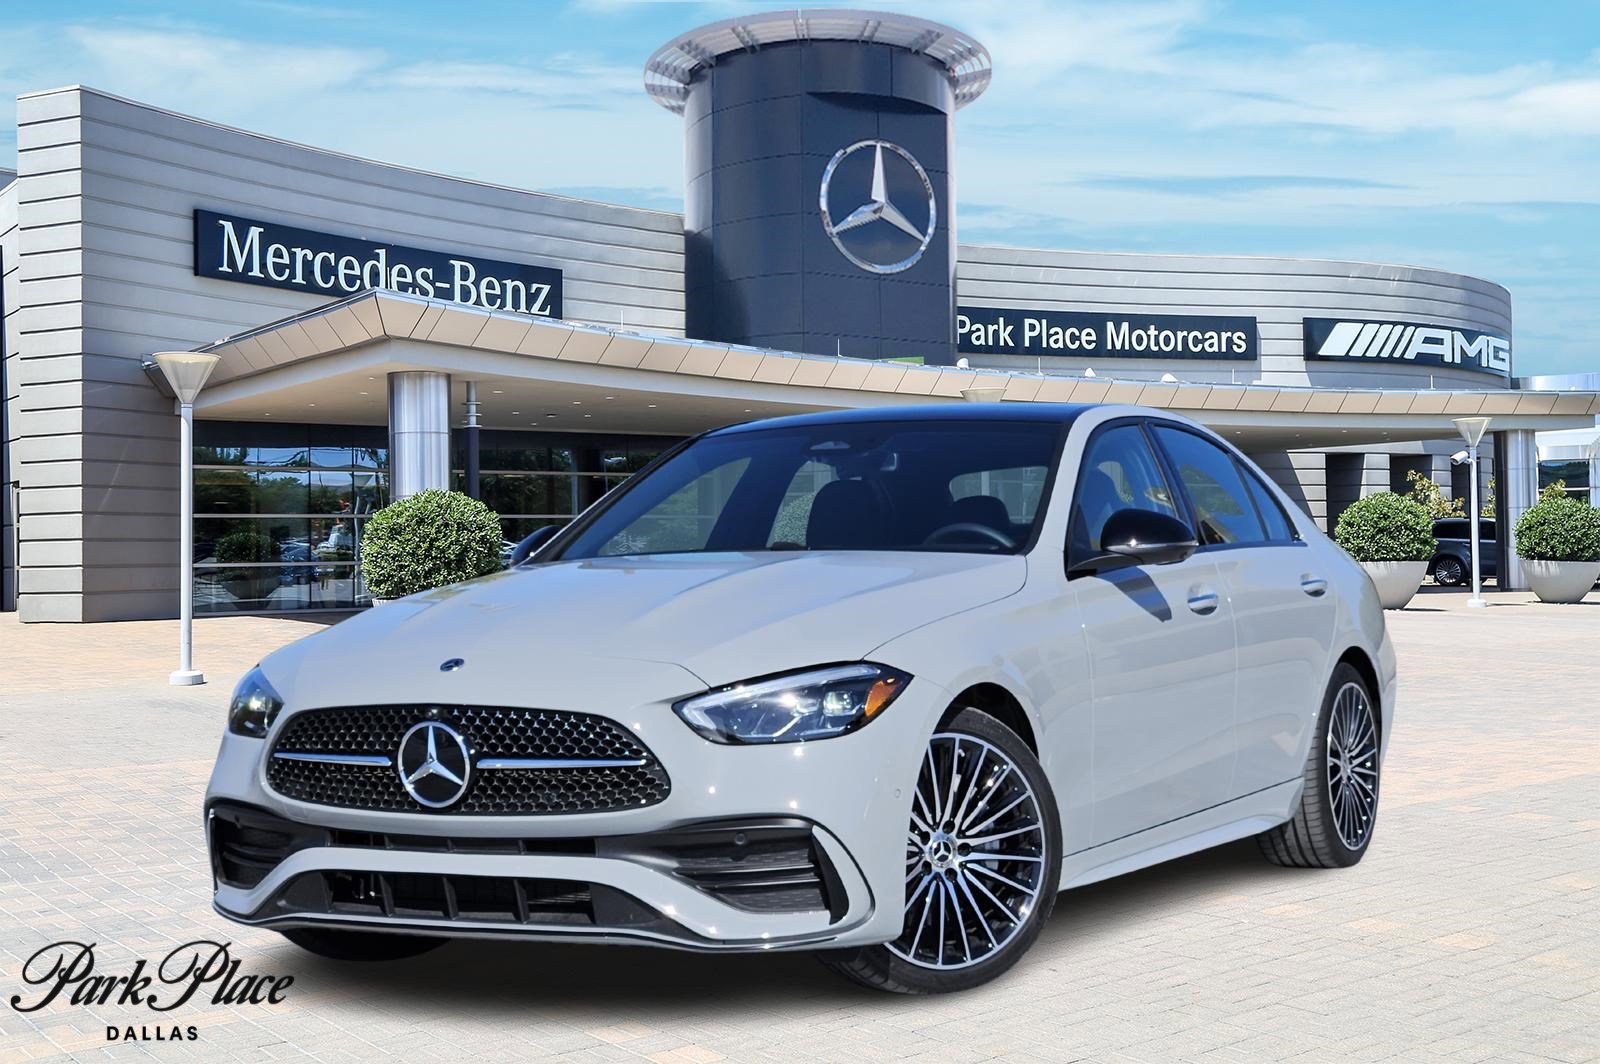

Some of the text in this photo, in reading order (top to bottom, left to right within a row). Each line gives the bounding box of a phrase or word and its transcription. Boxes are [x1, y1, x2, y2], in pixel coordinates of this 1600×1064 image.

[218, 219, 553, 317] Mercedes-Benz
[956, 314, 1248, 354] Park Place Motorcars
[1404, 326, 1511, 374] AMG
